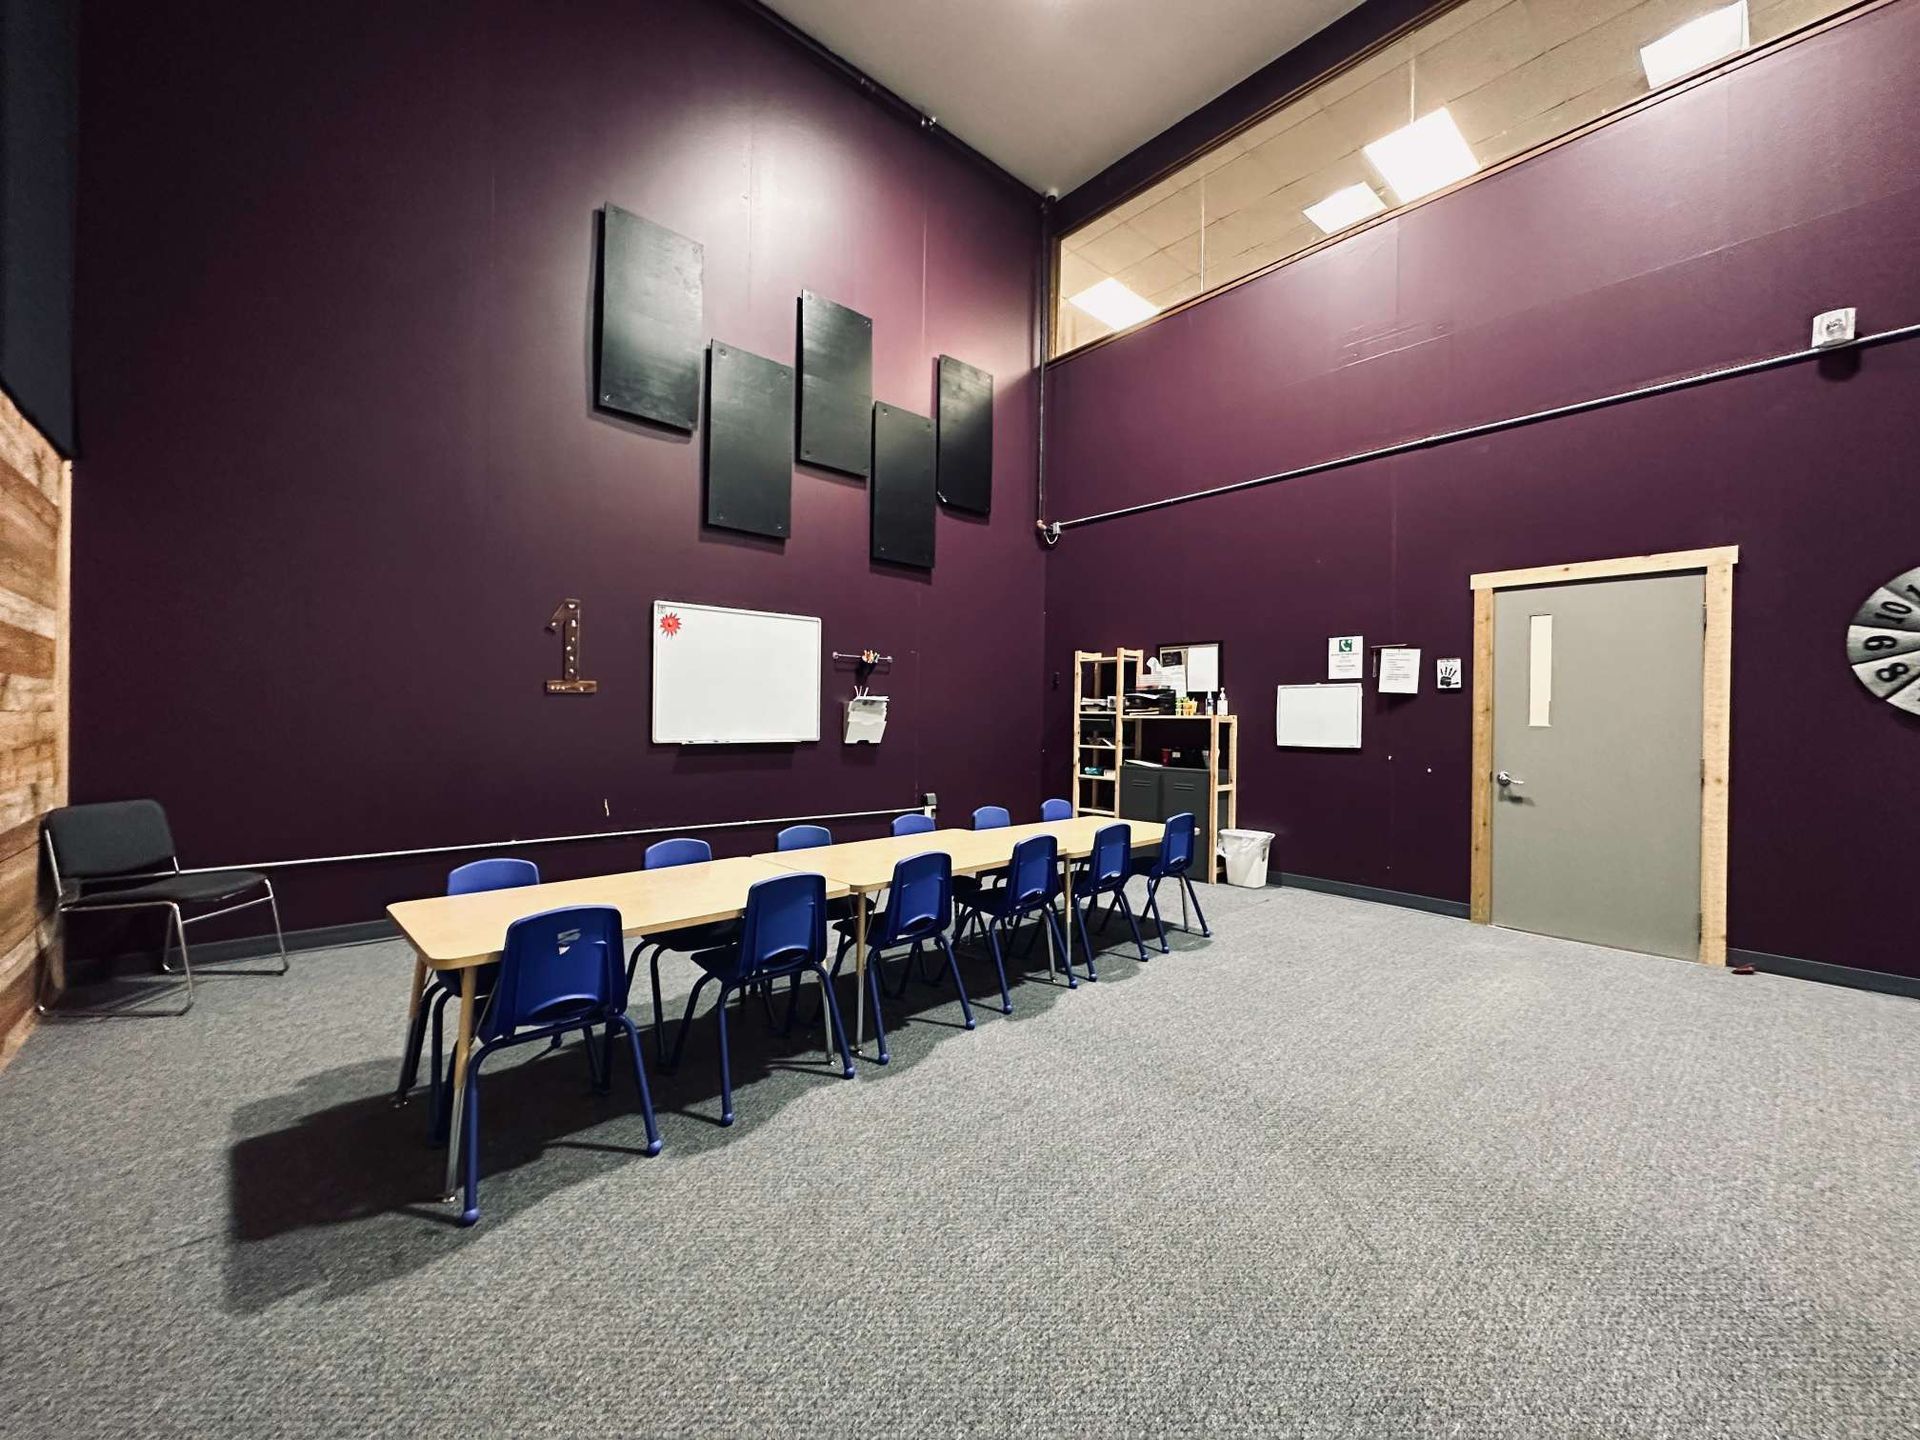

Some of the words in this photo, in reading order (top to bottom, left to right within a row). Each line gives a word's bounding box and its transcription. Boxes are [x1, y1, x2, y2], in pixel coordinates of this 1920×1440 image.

[1874, 601, 1913, 624] 10
[547, 598, 597, 693] 1
[1863, 635, 1898, 651] 9
[1875, 662, 1910, 682] 8
